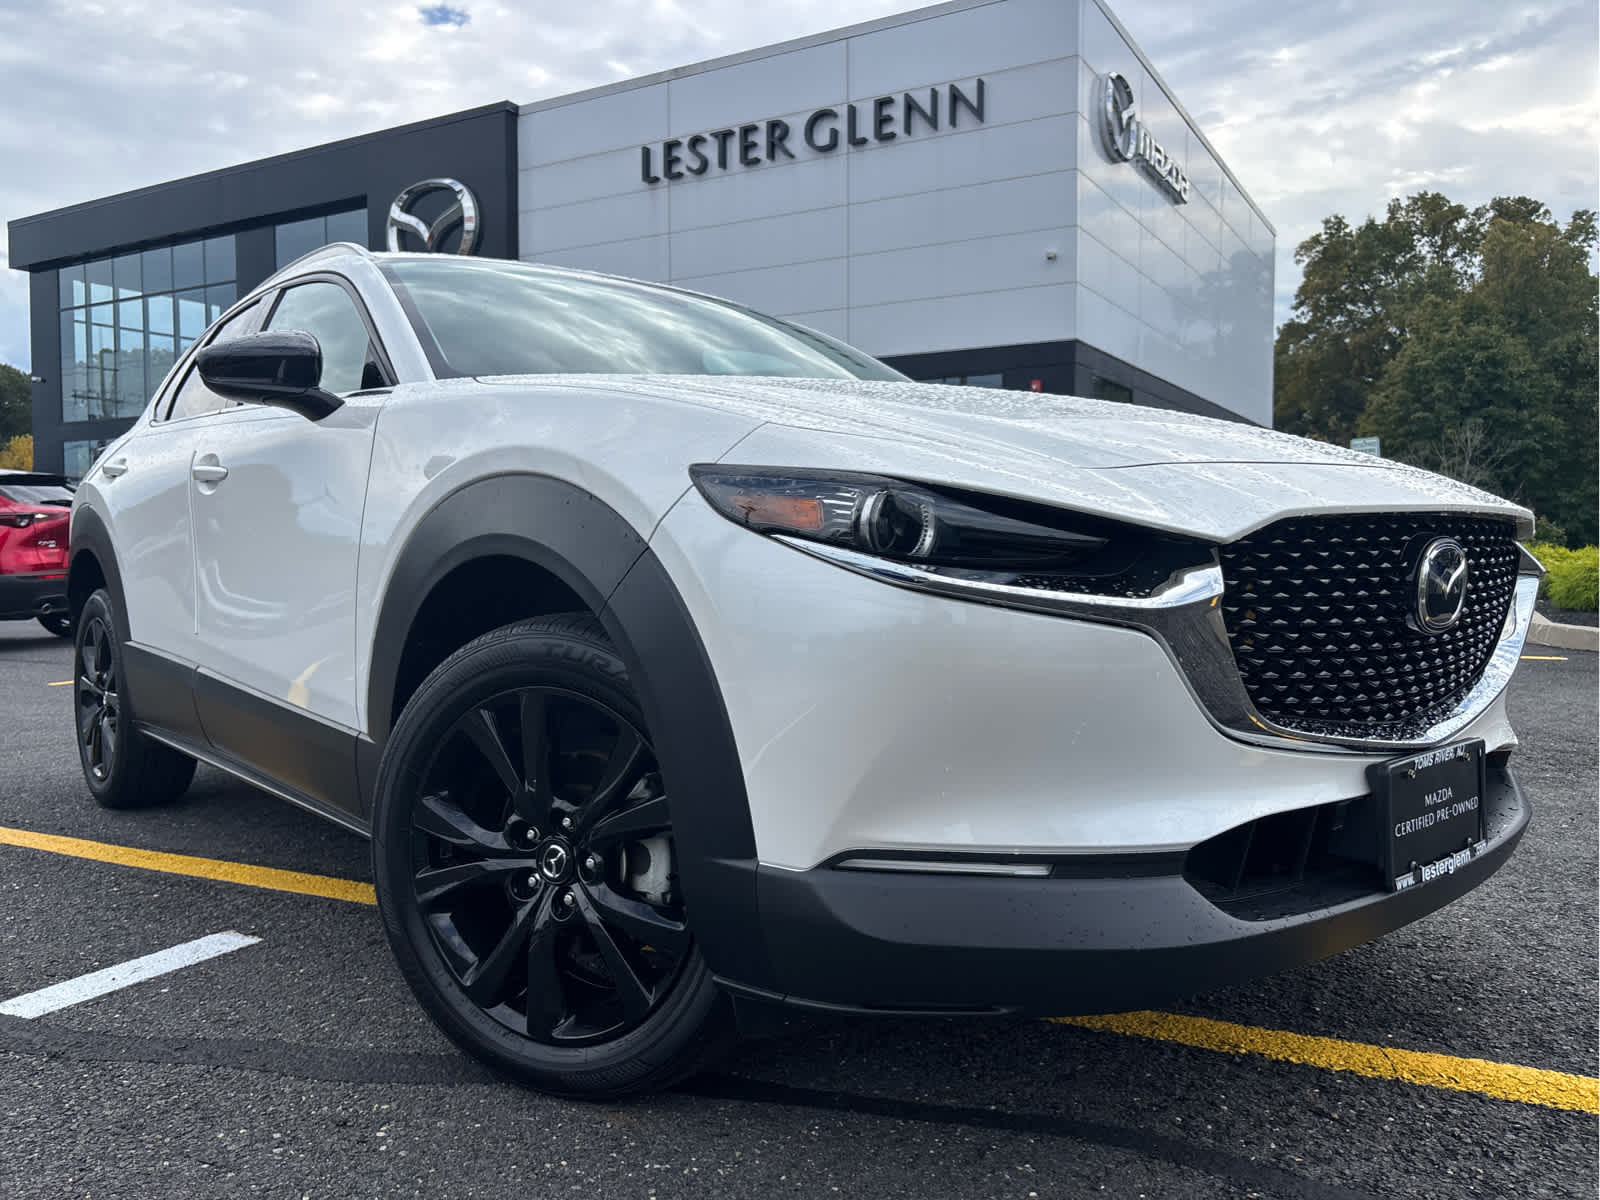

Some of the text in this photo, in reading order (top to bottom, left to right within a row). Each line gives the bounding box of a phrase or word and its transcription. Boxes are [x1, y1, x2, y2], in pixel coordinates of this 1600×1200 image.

[641, 78, 985, 184] LESTER GLENN
[1414, 755, 1434, 771] TOMS
[1456, 744, 1465, 758] NJ
[1425, 787, 1452, 807] MAZDA
[1395, 796, 1479, 837] CERTIFIED PRE-OWNED
[1421, 849, 1471, 882] lesterglenn
